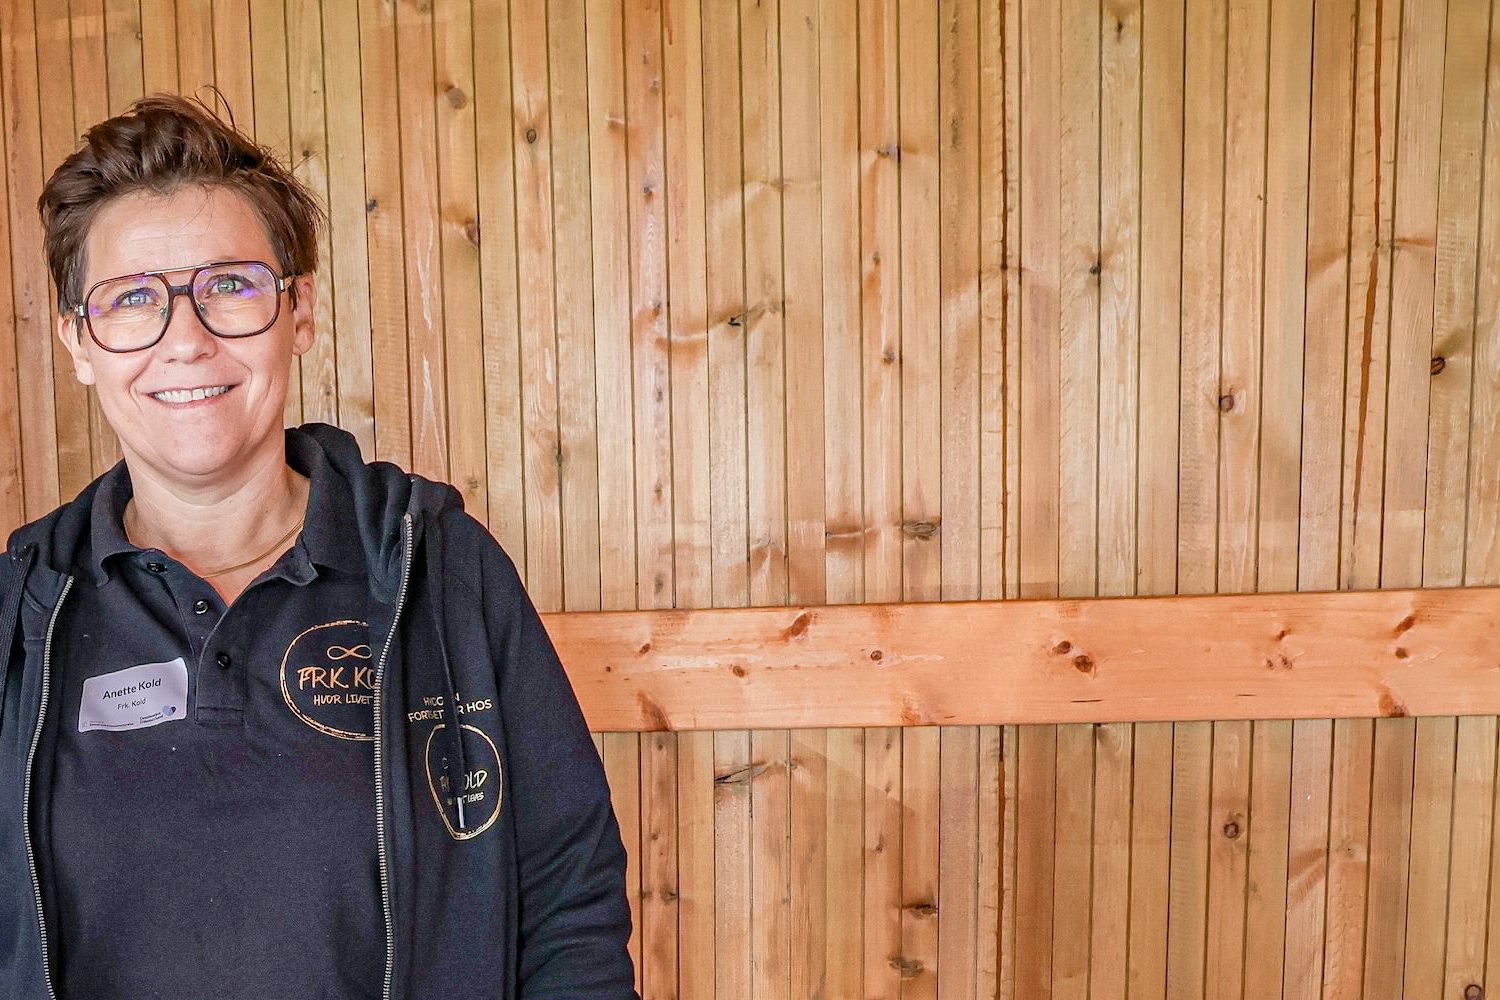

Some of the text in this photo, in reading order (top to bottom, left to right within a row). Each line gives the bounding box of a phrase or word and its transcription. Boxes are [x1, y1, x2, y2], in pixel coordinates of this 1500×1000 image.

[102, 678, 161, 700] Anette Kold
[132, 698, 146, 708] Kold
[313, 694, 342, 706] HVOR
[466, 699, 493, 713] HOS
